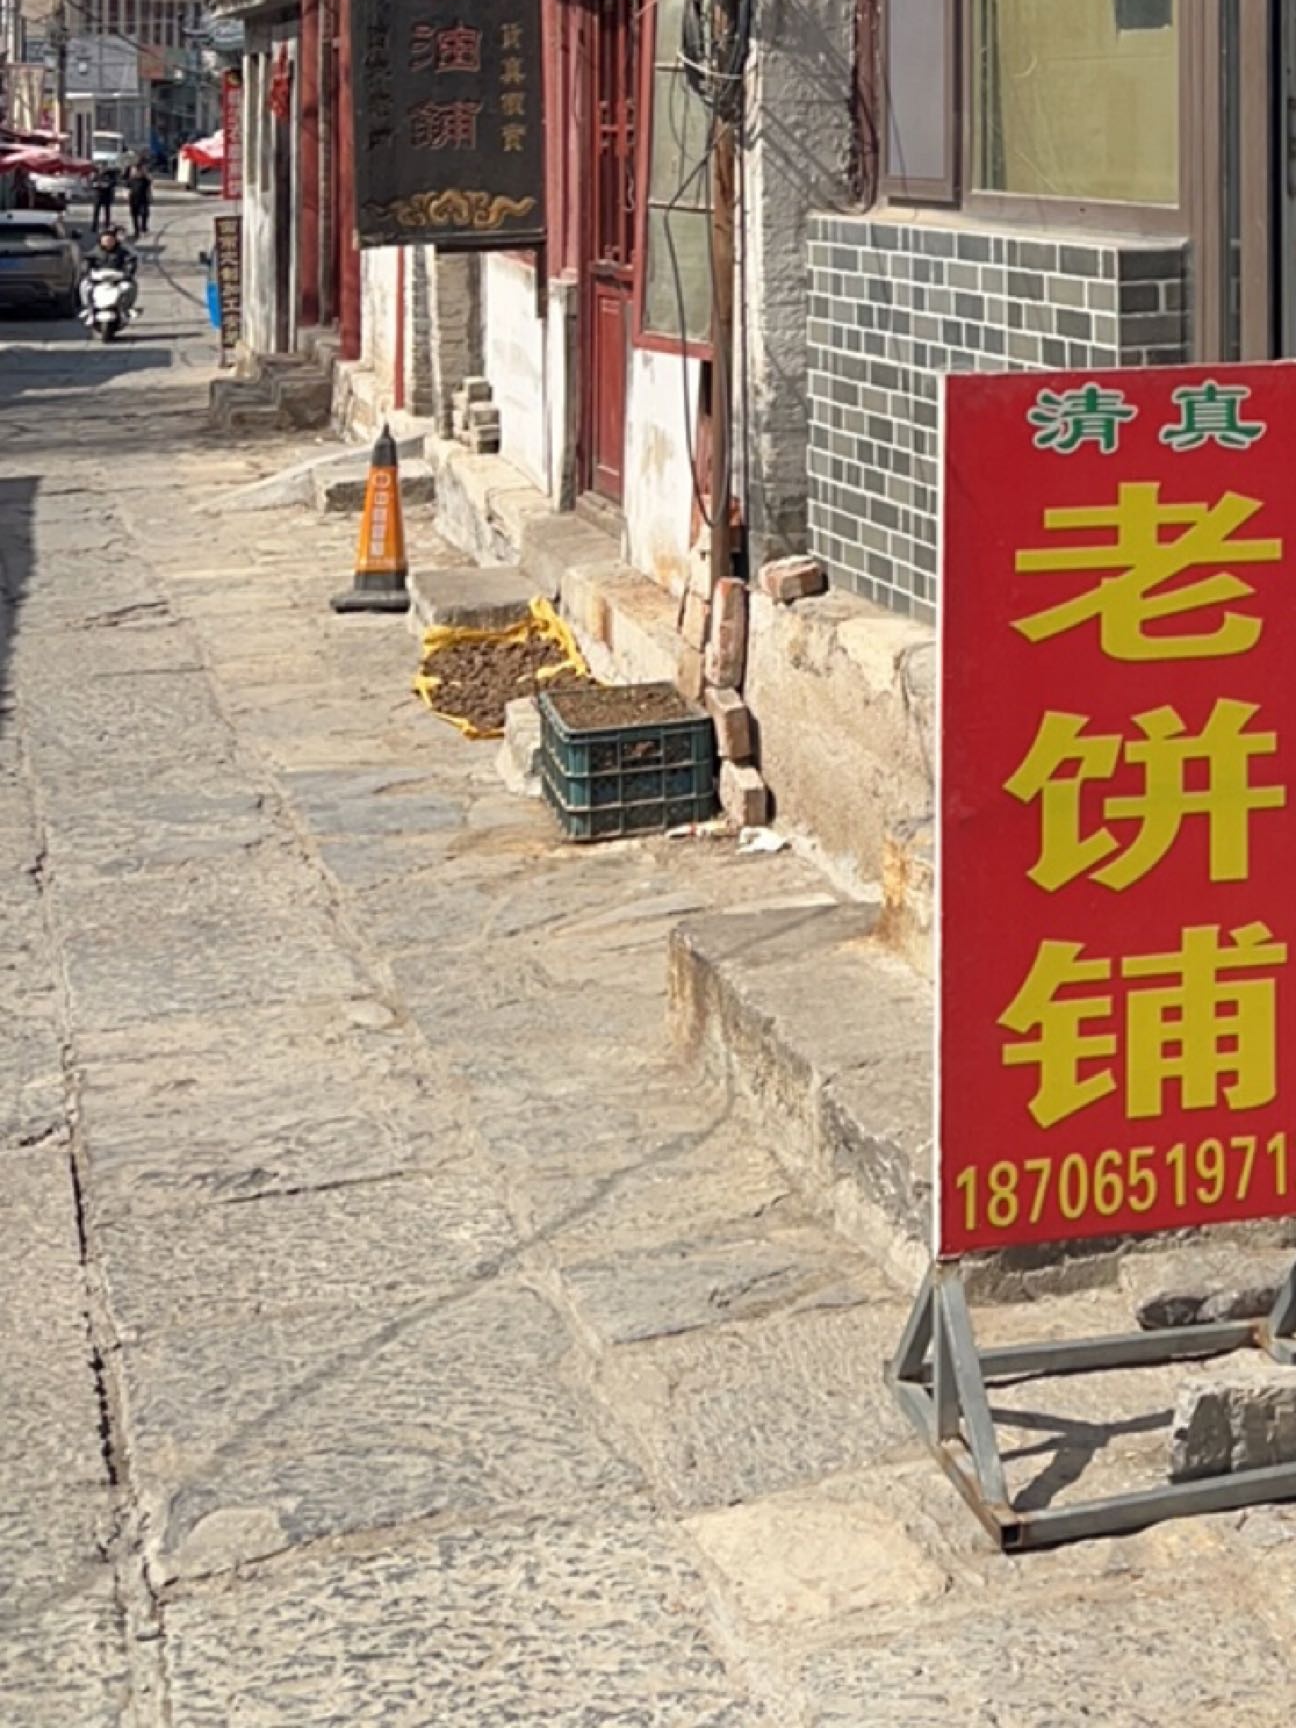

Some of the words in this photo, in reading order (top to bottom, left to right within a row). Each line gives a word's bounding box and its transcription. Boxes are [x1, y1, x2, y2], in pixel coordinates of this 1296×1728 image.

[1028, 379, 1267, 454] 清真
[997, 482, 1290, 1129] 老饼铺
